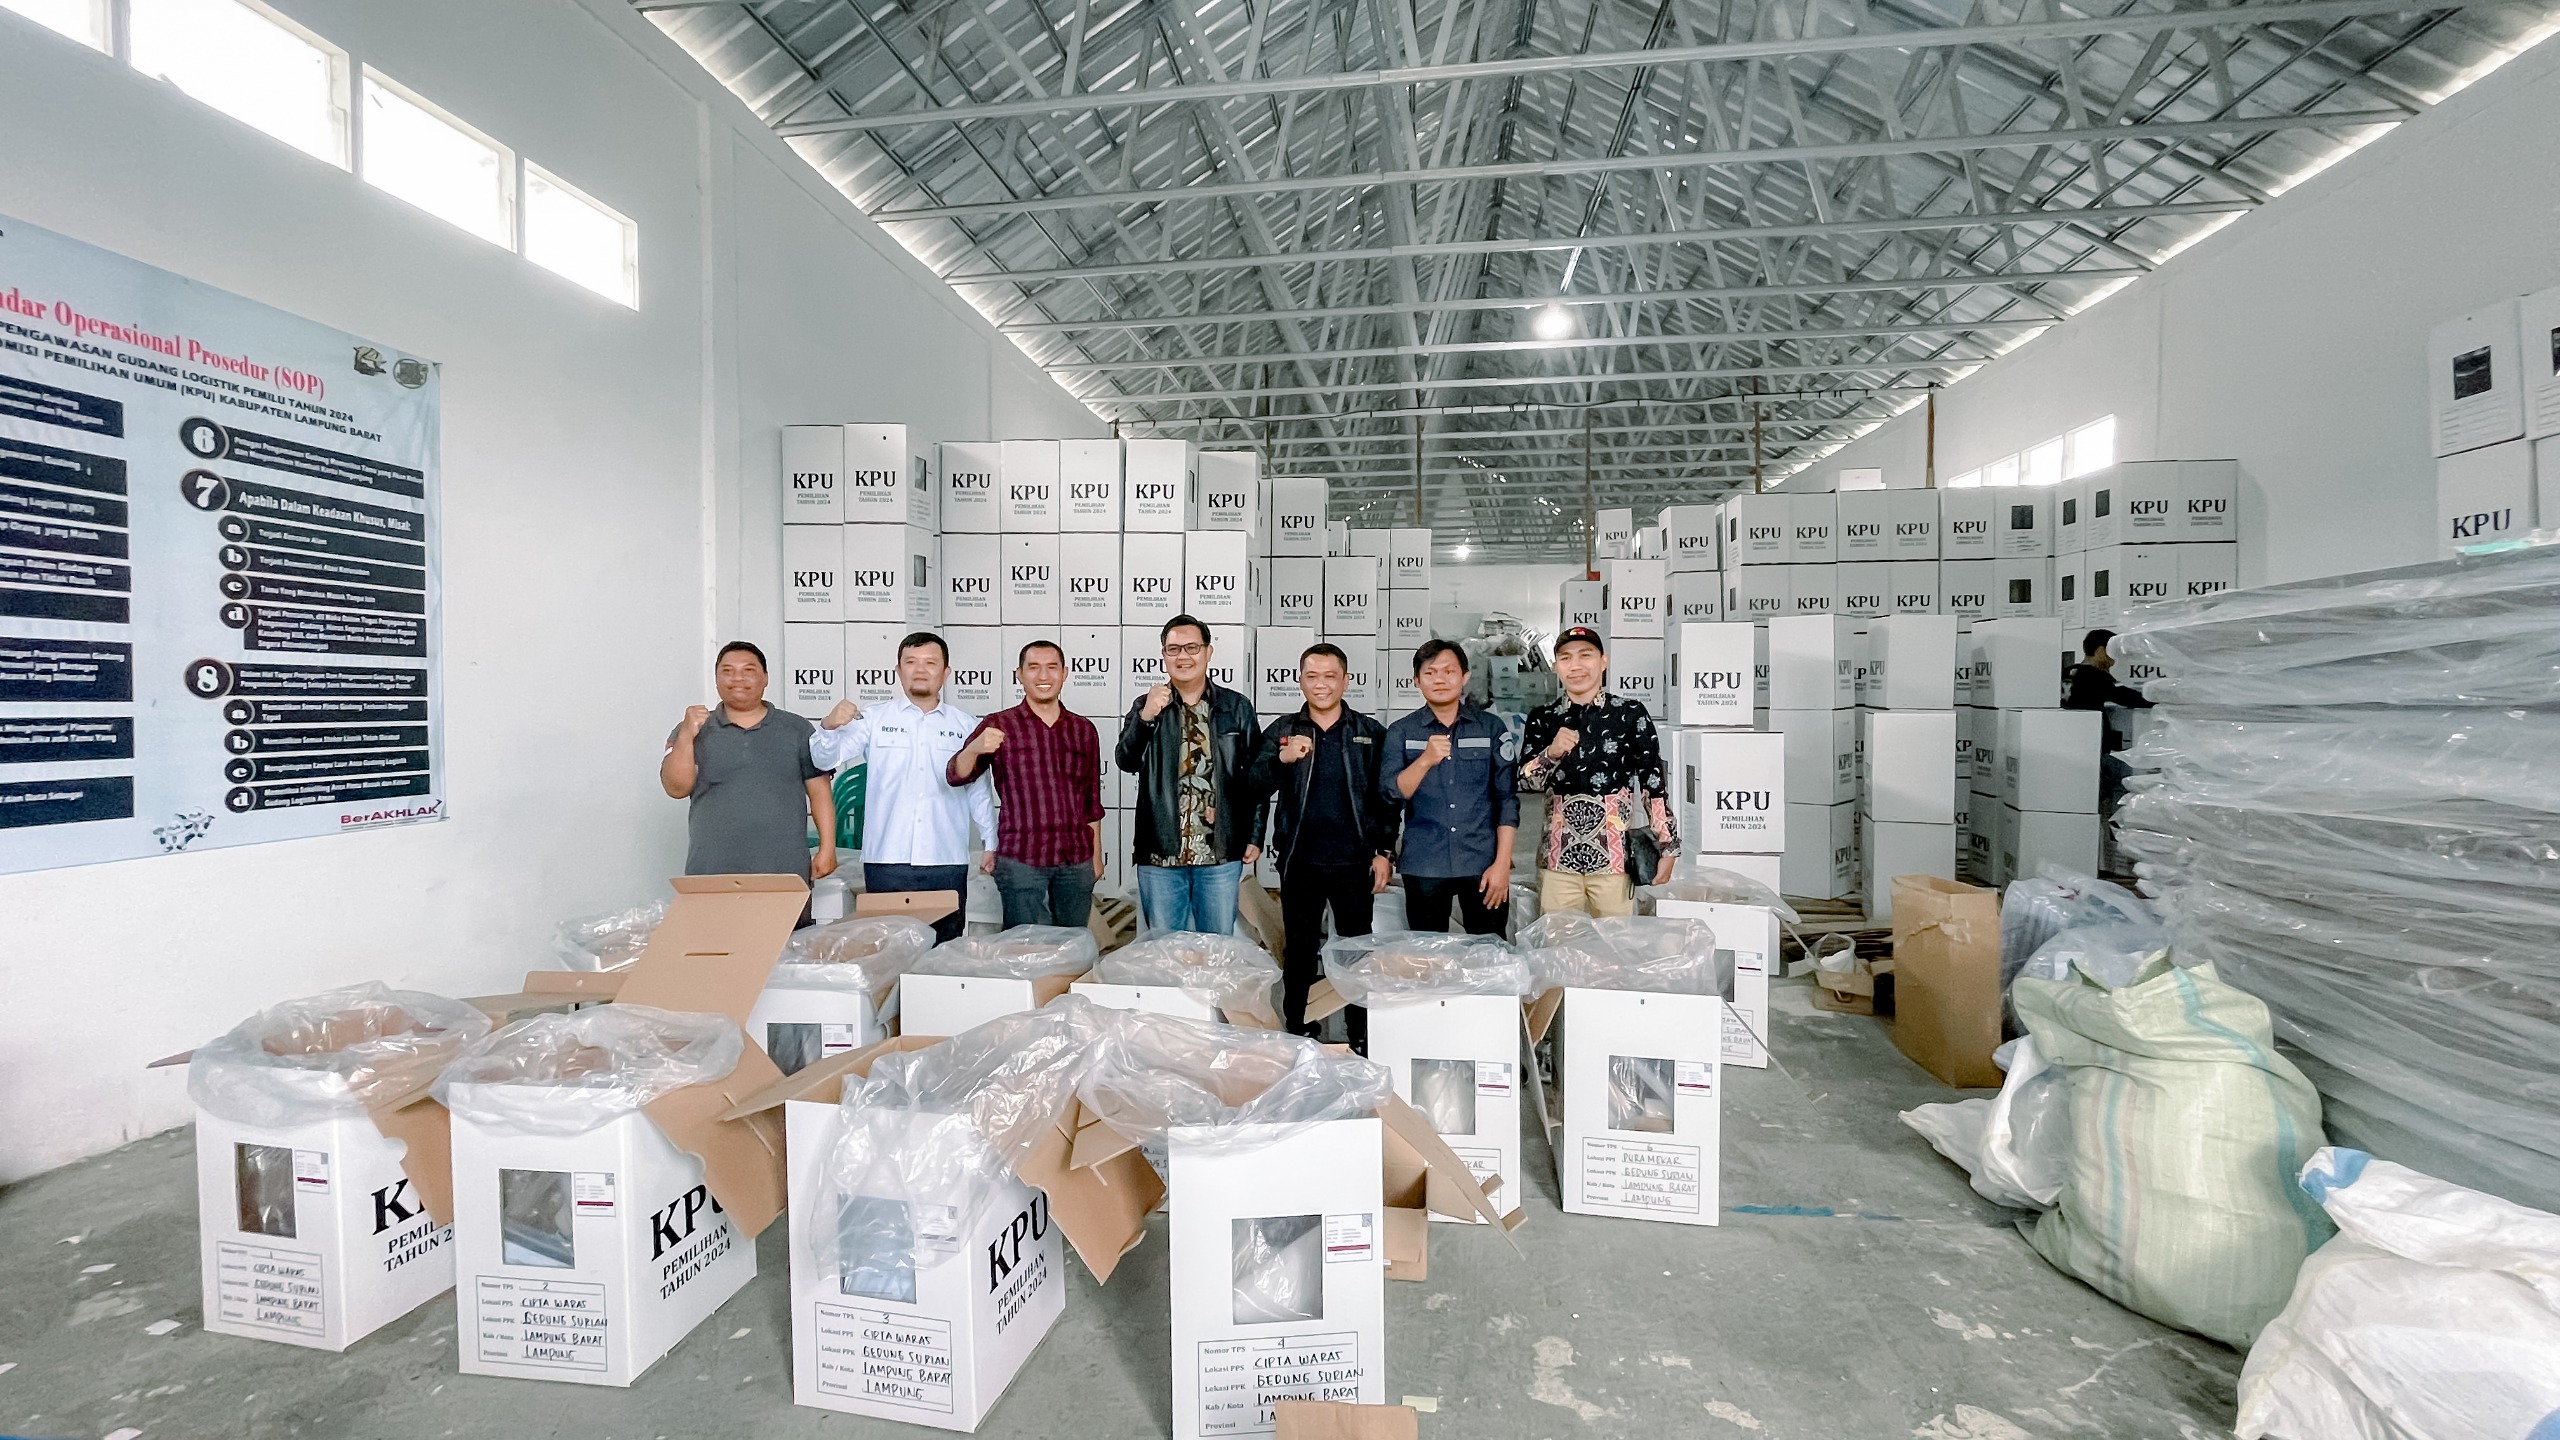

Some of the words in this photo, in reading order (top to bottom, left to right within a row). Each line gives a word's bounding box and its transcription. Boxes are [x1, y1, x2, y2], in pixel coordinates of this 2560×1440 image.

[54, 301, 182, 358] Operasional
[188, 339, 269, 382] Prosedur
[274, 365, 325, 401] (SOP)
[117, 353, 178, 377] GUDANG
[182, 370, 239, 393] LOGISTIK
[243, 386, 285, 405] PEMILU
[288, 398, 327, 416] TAHUN
[330, 409, 354, 423] 2024
[44, 349, 130, 379] PEMILIHAN
[134, 372, 177, 391] UMUM
[219, 394, 292, 420] KABUPATEN
[295, 413, 347, 434] LAMPUNG
[350, 427, 382, 443] BARAT
[193, 426, 217, 454] 6
[792, 473, 834, 489] KPU
[855, 470, 896, 487] KPU
[952, 473, 991, 488] KPU
[196, 475, 219, 508] 7
[239, 490, 279, 510] Apabila
[281, 500, 311, 515] Dalam
[1010, 485, 1050, 500] KPU
[1070, 484, 1109, 499] KPU
[1135, 484, 1175, 499] KPU
[1208, 493, 1246, 509] KPU
[2130, 500, 2169, 515] KPU
[2187, 499, 2227, 513] KPU
[1280, 516, 1315, 529] KPU
[1847, 524, 1880, 536] KPU
[1896, 522, 1930, 535] KPU
[1953, 521, 1987, 535] KPU
[2452, 509, 2511, 539] KPU
[1605, 531, 1628, 541] KPU
[1750, 527, 1781, 539] KPU
[1796, 526, 1828, 539] KPU
[1679, 536, 1709, 548] KPU
[1397, 557, 1423, 567] KPU
[793, 571, 834, 587] KPU
[854, 570, 895, 587] KPU
[1011, 565, 1050, 581] KPU
[952, 577, 990, 593] KPU
[1070, 578, 1109, 593] KPU
[1132, 578, 1172, 593] KPU
[1195, 575, 1236, 591] KPU
[2129, 583, 2168, 597] KPU
[2187, 582, 2227, 595] KPU
[1279, 595, 1314, 609] KPU
[1333, 594, 1368, 608] KPU
[1621, 597, 1656, 610] KPU
[1749, 598, 1781, 610] KPU
[1797, 597, 1830, 609] KPU
[1847, 595, 1880, 608] KPU
[1897, 594, 1931, 607] KPU
[1951, 594, 1985, 607] KPU
[228, 607, 244, 621] d
[1684, 603, 1714, 615] KPU
[1396, 618, 1423, 628] KPU
[1071, 657, 1110, 673] KPU
[1755, 665, 1770, 677] KP
[1975, 662, 1993, 677] KPU
[197, 665, 219, 692] 8
[794, 669, 834, 685] KPU
[856, 669, 896, 685] KPU
[954, 670, 992, 685] KPU
[1208, 668, 1234, 683] PU
[1693, 672, 1741, 689] KPU
[1620, 677, 1655, 690] KPU
[232, 735, 249, 750] b
[232, 792, 249, 807] d
[1715, 791, 1771, 811] KPU
[340, 805, 438, 824] BerAKHLAK
[388, 1220, 437, 1254] PEMIL
[987, 1191, 1050, 1295] KPU
[383, 1234, 440, 1272] TAHUN
[662, 1222, 728, 1281] PEMILIHAN
[660, 1263, 701, 1301] TAHUN
[704, 1238, 731, 1267] 2024
[997, 1249, 1045, 1314] PEMILIHAN
[995, 1294, 1026, 1335] TAHUN
[1027, 1270, 1047, 1304] 2024
[882, 1313, 890, 1325] 3
[863, 1328, 893, 1341] CIPTA
[896, 1334, 932, 1346] WARAS
[1204, 1347, 1229, 1355] Nomor
[1277, 1337, 1285, 1349] 4
[1204, 1365, 1228, 1373] Lokasi
[1230, 1364, 1245, 1372] PPS
[1254, 1356, 1292, 1369] CIPTA
[1299, 1351, 1343, 1365] WARAS
[862, 1362, 912, 1381] LAMPUNG
[919, 1370, 952, 1384] BARAT
[1204, 1384, 1229, 1392] Lokasi
[1230, 1383, 1246, 1391] PPK
[1318, 1367, 1364, 1383] SURIAN
[863, 1379, 924, 1400] LAMPUNG
[1205, 1403, 1218, 1411] Kab
[1227, 1402, 1244, 1410] Kota
[1323, 1386, 1359, 1401] BARAT
[1205, 1421, 1236, 1429] Provinsi
